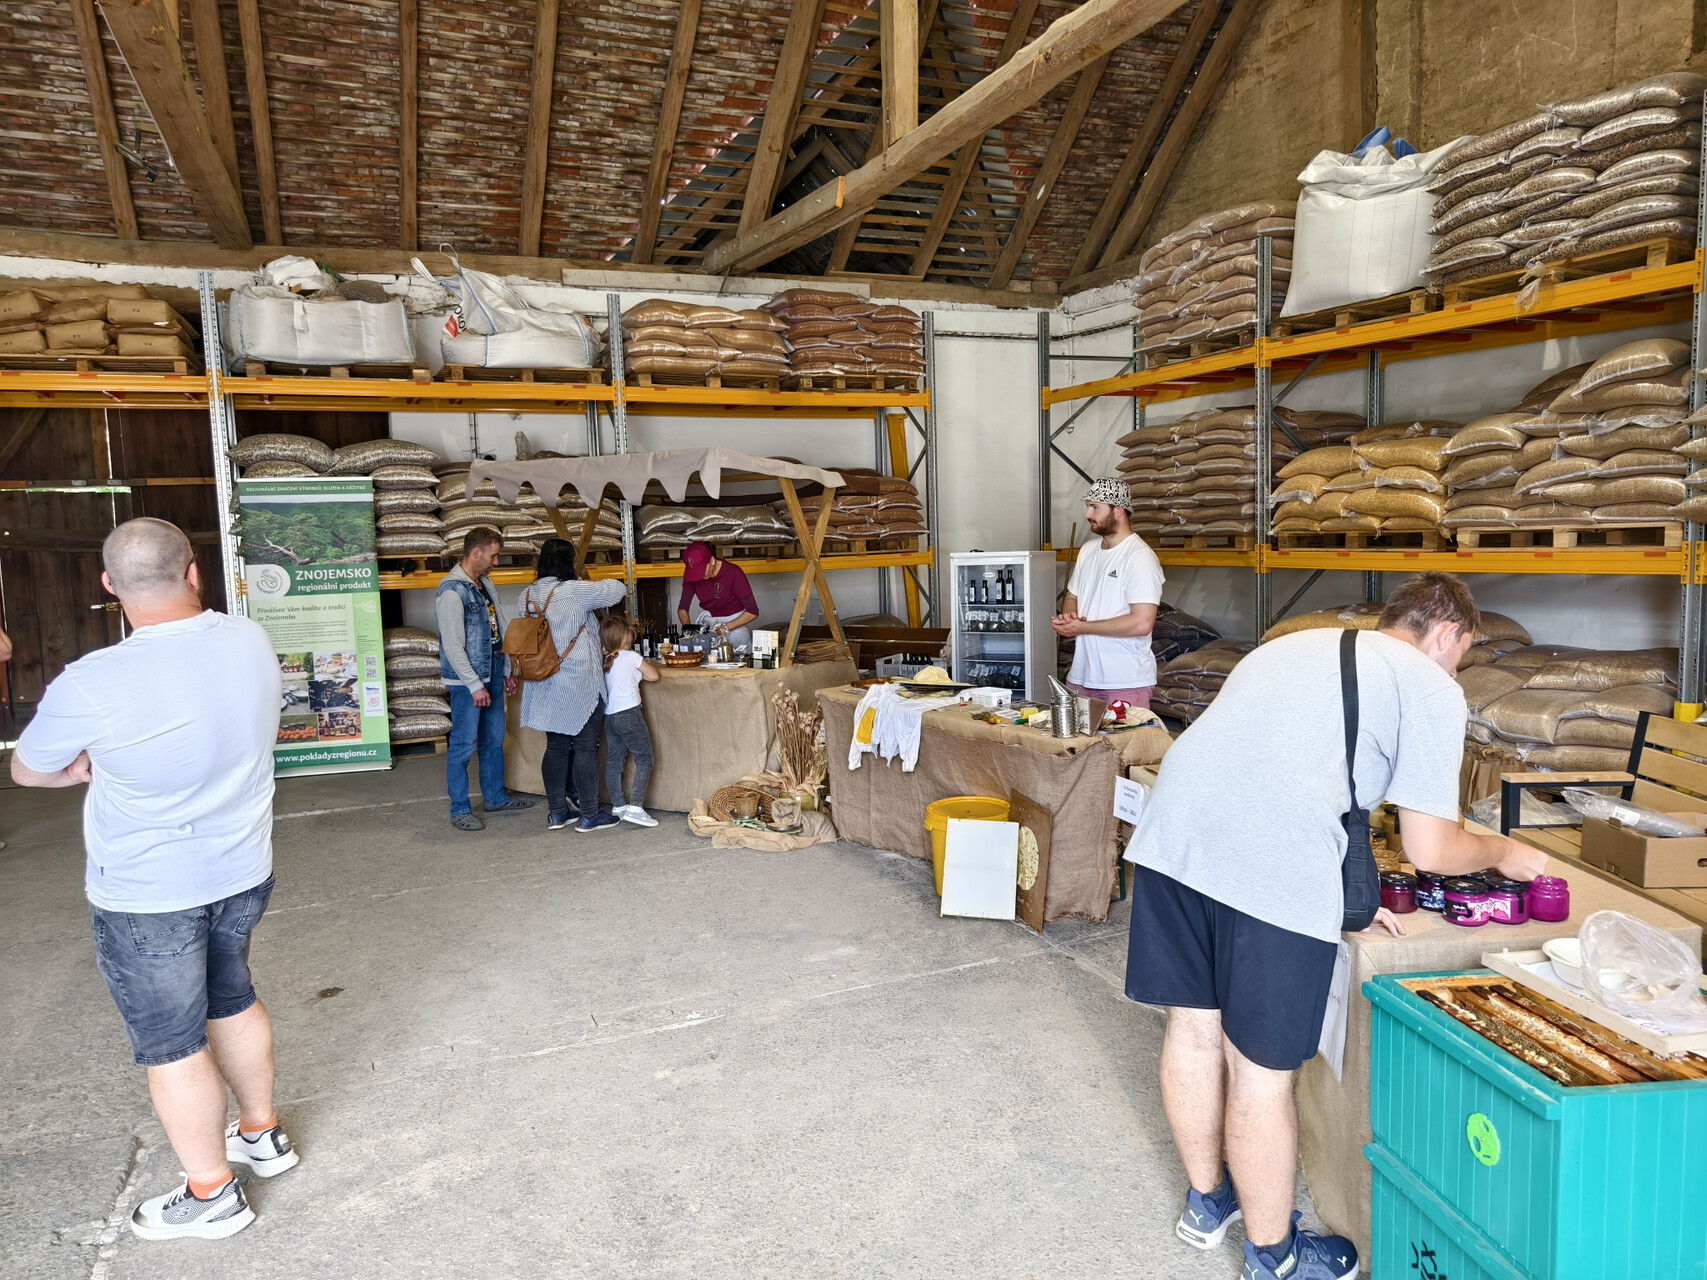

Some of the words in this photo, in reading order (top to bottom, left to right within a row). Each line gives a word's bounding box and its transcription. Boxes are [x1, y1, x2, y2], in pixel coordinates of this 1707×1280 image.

[295, 568, 372, 580] ZNOJEMSKO
[297, 582, 338, 593] regionální
[340, 581, 371, 591] produkt
[257, 606, 286, 615] Přinášíme
[265, 614, 296, 622] Znojemska
[276, 749, 377, 763] www.pokladyzregionu.cz
[1274, 1253, 1295, 1278] PUMA
